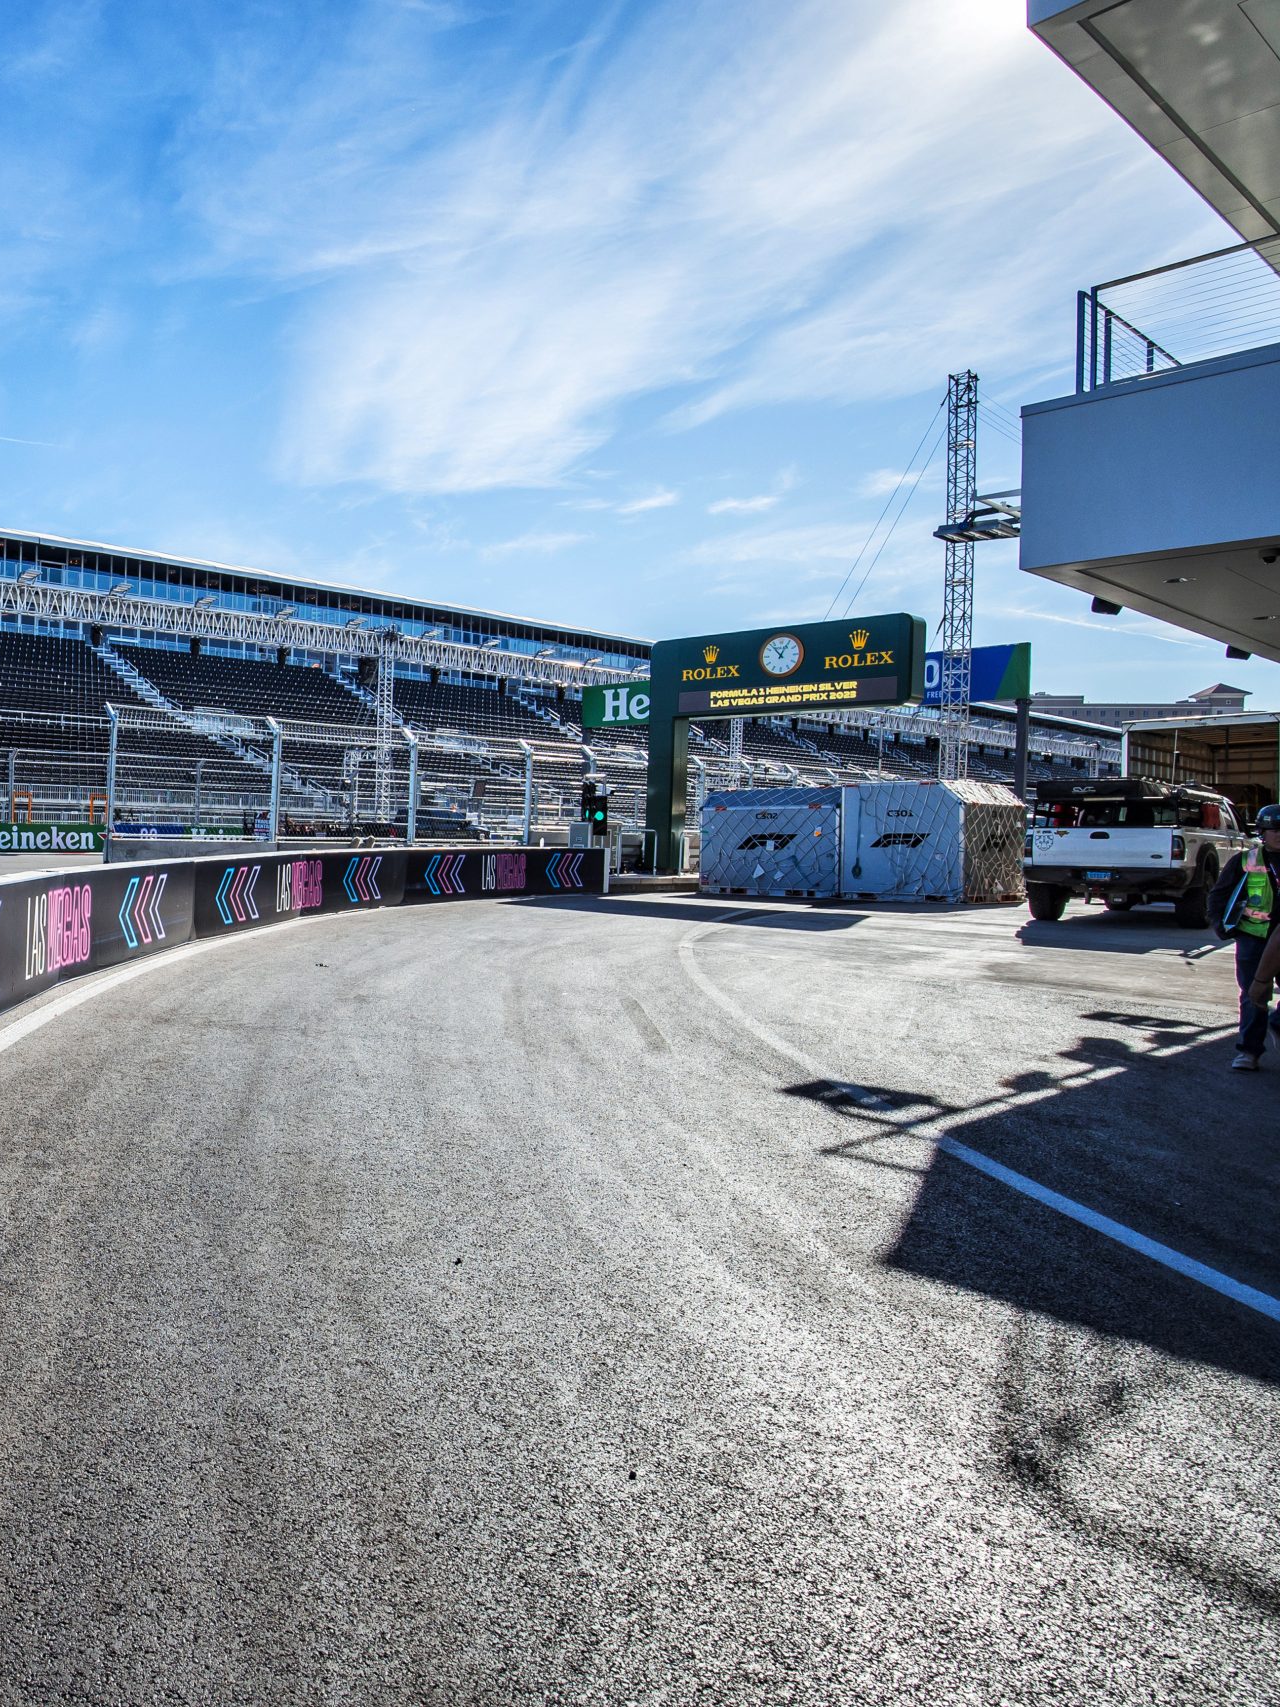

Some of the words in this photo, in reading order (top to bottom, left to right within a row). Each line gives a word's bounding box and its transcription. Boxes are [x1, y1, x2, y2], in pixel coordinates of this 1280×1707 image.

[823, 650, 895, 670] ROLEX
[681, 664, 741, 682] ROLEX
[710, 688, 758, 699] FORMULA
[759, 688, 765, 696] 1
[766, 683, 818, 695] HEINEKEN
[818, 681, 858, 692] SILVER
[710, 698, 730, 708] LAS
[730, 696, 765, 707] VEGAS
[765, 694, 802, 704] GRAND
[802, 692, 829, 702] PRIX
[829, 690, 857, 700] 2023
[482, 854, 496, 890] LAS
[496, 853, 527, 890] VEGAS
[276, 863, 292, 912] LAS
[292, 859, 323, 910] VEGAS
[25, 893, 47, 980] LAS
[47, 884, 92, 972] VEGAS
